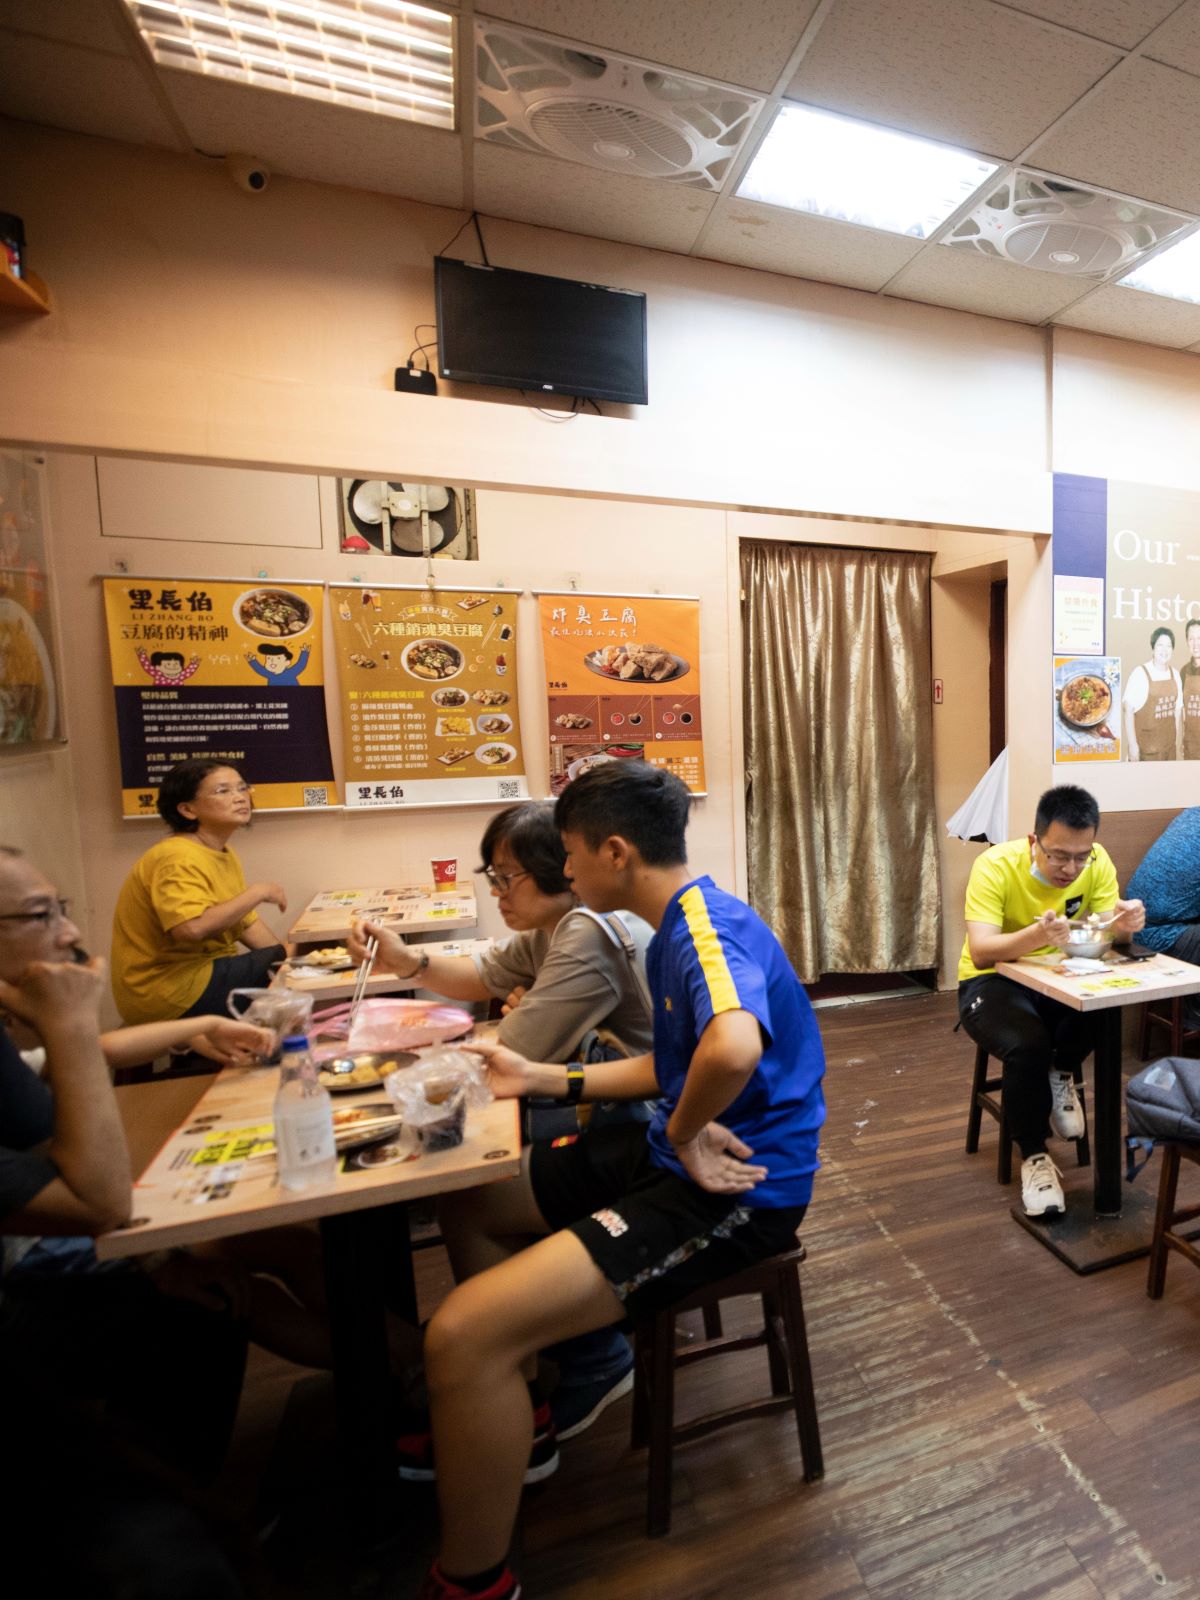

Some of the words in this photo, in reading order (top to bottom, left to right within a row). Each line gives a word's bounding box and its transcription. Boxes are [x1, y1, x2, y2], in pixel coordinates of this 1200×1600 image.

[1113, 530, 1180, 566] Our
[128, 589, 213, 612] 里長伯
[132, 613, 144, 621] LI
[150, 614, 193, 622] ZHANG
[198, 614, 214, 622] BO
[552, 605, 637, 626] 炸臭豆腐
[121, 624, 229, 642] 豆腐的精神
[373, 622, 483, 638] 六種銷魂臭豆腐
[358, 786, 404, 799] 里長伯
